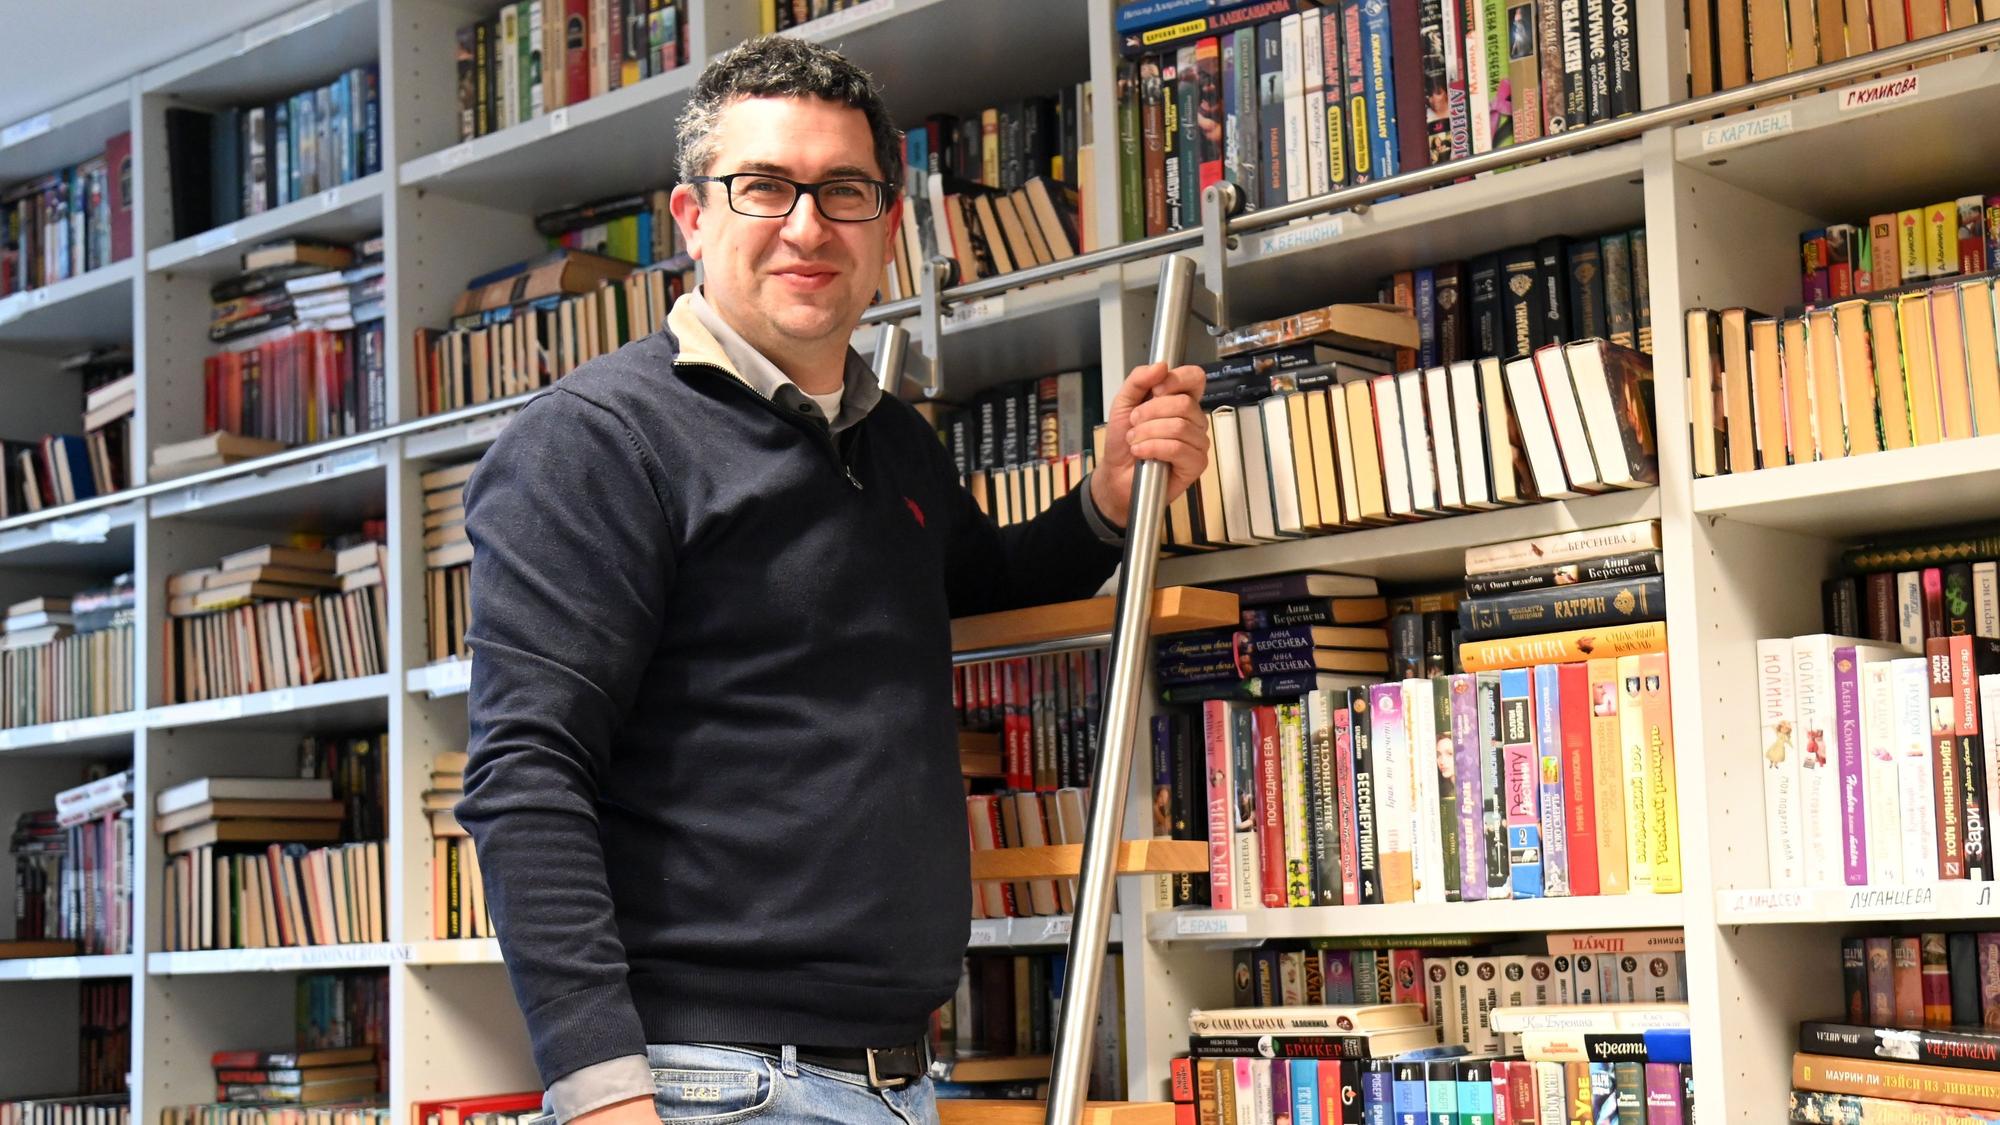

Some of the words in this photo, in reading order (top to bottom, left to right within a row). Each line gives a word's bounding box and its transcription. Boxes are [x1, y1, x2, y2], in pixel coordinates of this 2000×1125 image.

[1620, 38, 1631, 72] АРСАН
[1597, 62, 1608, 95] АРСАН
[1856, 77, 1917, 104] КУЛИКОВА
[1574, 73, 1584, 113] АЛЬТЕР
[1279, 222, 1339, 249] БЕНЦОНИ
[1514, 301, 1530, 356] МАРИАННА
[1567, 535, 1628, 552] БЕРСЕНЕВА
[1588, 563, 1647, 580] Берсенева
[1602, 557, 1629, 569] Анна
[1489, 581, 1511, 590] Опыт
[1273, 612, 1327, 626] Берсенева
[1286, 603, 1310, 615] Анна
[1554, 596, 1607, 619] КАТРИН
[1256, 637, 1309, 653] БЕРСЕНЕВА
[1269, 629, 1291, 640] АННА
[1271, 652, 1293, 663] АННА
[1480, 639, 1568, 666] БЕРСЕНЕВА
[1259, 659, 1312, 674] БЕРСЕНЕВА
[1932, 655, 1941, 684] КЛАРК
[1941, 655, 1950, 684] ЛЮСИ
[1959, 648, 1971, 686] Каргар
[1764, 654, 1783, 719] КОЛИНА
[1798, 651, 1816, 716] КОЛИНА
[1516, 702, 1525, 740] БОУМЕН
[1542, 686, 1553, 733] Белоусова
[1299, 698, 1309, 766] ЛАКОМСТВО
[1508, 709, 1518, 740] САЛЛИ
[1264, 735, 1274, 757] ЕВА
[1632, 743, 1643, 773] ВОР
[1311, 743, 1323, 796] БАРБЕРИ
[1386, 767, 1394, 779] по
[1650, 724, 1667, 796] рыцарь
[1320, 739, 1334, 831] ЭЛЕГАНТНОСТЬ
[1509, 751, 1528, 817] Destiny
[1572, 748, 1583, 801] БУЛГАКОВА
[1941, 739, 1956, 822] ЕДИНСТВЕННЫЙ
[1265, 759, 1277, 827] ПОСЛЕДНЯЯ
[1384, 784, 1396, 809] Брак
[1356, 771, 1374, 871] БЕССМЕРТНИКИ
[1550, 792, 1562, 828] СМЕРТЬ
[1574, 805, 1585, 832] ИННА
[1209, 797, 1229, 887] БЕРСЕНЕВА
[1313, 798, 1325, 859] МЮРИЕЛЬ
[1518, 828, 1527, 846] 2
[1552, 828, 1563, 852] МОЮ
[1946, 826, 1957, 857] ВДОХ
[1965, 807, 1984, 856] Зари
[1241, 837, 1252, 898] БЕРСЕНЕВА
[1850, 887, 1933, 909] ЛУГАНЦЕВА
[1190, 919, 1227, 932] БРАУН
[1572, 936, 1625, 953] Шмуц
[1647, 936, 1684, 946] ЕРЛИНЕР
[1478, 998, 1488, 1012] ДВЕ
[1211, 1018, 1250, 1031] САНДРА
[1252, 1017, 1286, 1030] БРАУН
[1291, 1019, 1329, 1029] ЗАЛОЖНИЦА
[1479, 1013, 1489, 1028] КАК
[1286, 1043, 1342, 1057] БРИКЕР
[1815, 1031, 1842, 1043] АНГЕЛА
[1841, 1033, 1860, 1044] ДЕНЬ
[1925, 1039, 1996, 1062] МУРАВЬЁВА
[1199, 1069, 1215, 1101] БЛОК
[1371, 1073, 1383, 1101] РОБЕРТ
[1400, 1068, 1412, 1081] #1
[1468, 1069, 1479, 1081] #1
[1825, 1069, 1863, 1083] МАУРИН
[1865, 1073, 1880, 1084] ЛИ
[1882, 1073, 1921, 1090] ЛЭЙСИ
[1923, 1078, 1939, 1092] ИЗ
